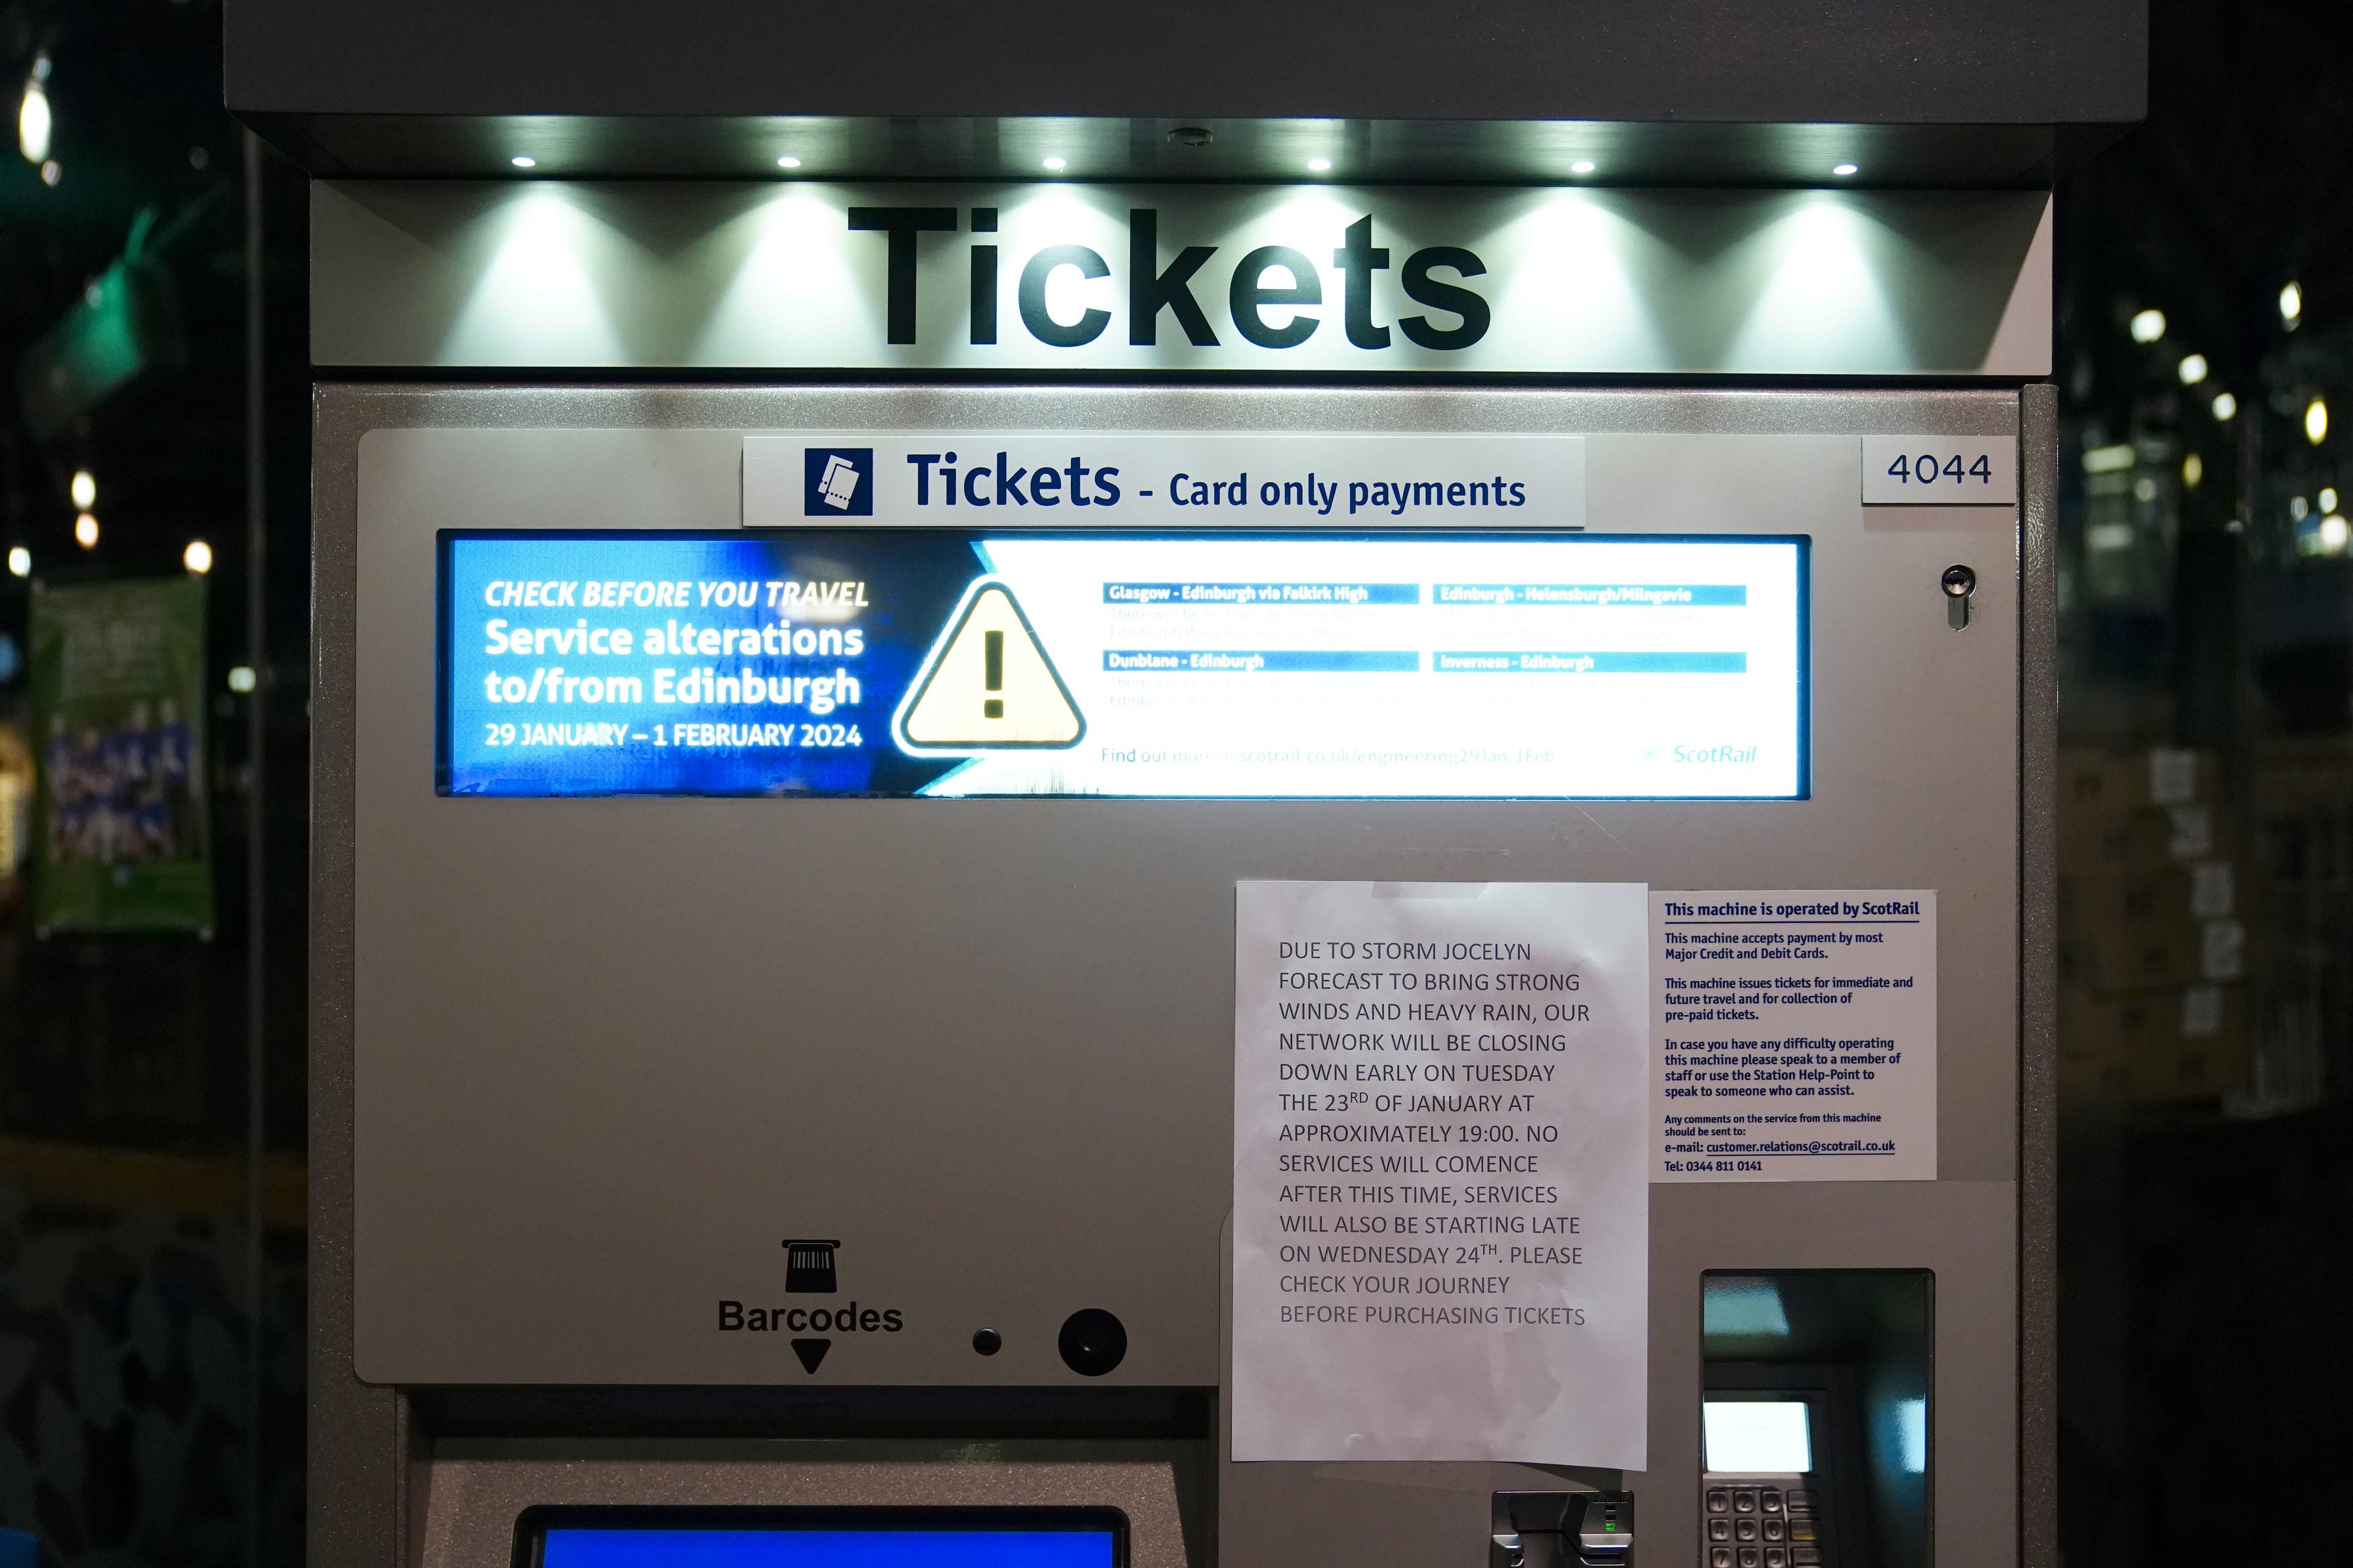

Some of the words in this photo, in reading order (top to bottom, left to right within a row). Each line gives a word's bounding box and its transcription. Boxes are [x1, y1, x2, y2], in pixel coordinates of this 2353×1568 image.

[848, 206, 1490, 350] Tickets
[1888, 454, 1992, 485] 4044
[906, 451, 1121, 507] Tickets
[1170, 472, 1248, 506] Card
[1260, 472, 1338, 515] only
[1349, 476, 1525, 515] payments
[485, 581, 578, 607] CHECK
[582, 581, 692, 607] BEFORE
[699, 581, 758, 607] YOU
[766, 581, 869, 608] TRAVEL
[1109, 585, 1170, 603] Glasgow
[1182, 585, 1256, 603] Edinburgh
[1258, 585, 1281, 600] via
[1283, 586, 1332, 600] Falkirk
[1334, 586, 1368, 603] High
[1441, 587, 1514, 604] Edinburgh
[1525, 587, 1691, 604] Helensburgh/Milngavie
[485, 619, 633, 655] Service
[643, 619, 863, 655] alterations
[1109, 653, 1179, 667] Dunblane
[1190, 653, 1264, 671] Edinburgh
[1441, 655, 1509, 669] Inverness
[1521, 655, 1594, 671] Edinburgh
[484, 667, 642, 703] to/from
[654, 667, 859, 714] Edinburgh
[485, 723, 516, 745] 29
[520, 723, 629, 746] JANUARY
[653, 725, 668, 746] 1
[674, 723, 795, 746] FEBRUARY
[801, 724, 862, 746] 2024
[1101, 747, 1136, 764] Find
[1141, 749, 1167, 764] out
[1674, 745, 1757, 763] ScotRail
[1665, 902, 1694, 916] This
[1698, 902, 1757, 916] machine
[1760, 902, 1773, 915] is
[1776, 901, 1839, 919] operated
[1843, 901, 1860, 919] by
[1862, 901, 1920, 915] ScotRail
[1665, 932, 1688, 944] This
[1691, 932, 1739, 944] machine
[1741, 932, 1785, 946] accepts
[1787, 932, 1837, 946] payment
[1839, 932, 1853, 946] by
[1855, 932, 1884, 943] most
[1279, 942, 1320, 959] DUE
[1326, 942, 1355, 959] TO
[1362, 942, 1436, 960] STORM
[1443, 943, 1530, 960] JOCELYN
[1665, 948, 1698, 962] Major
[1700, 948, 1734, 959] Credit
[1736, 947, 1757, 959] and
[1761, 947, 1792, 959] Debit
[1794, 947, 1829, 959] Cards.
[1280, 972, 1384, 990] FORECAST
[1389, 973, 1417, 990] TO
[1425, 973, 1488, 991] BRING
[1495, 973, 1579, 991] STRONG
[1665, 977, 1687, 989] This
[1689, 977, 1736, 989] machine
[1738, 977, 1772, 989] issues
[1774, 977, 1812, 989] tickets
[1813, 977, 1830, 988] for
[1831, 976, 1890, 988] immediate
[1892, 976, 1913, 988] and
[1665, 993, 1700, 1005] future
[1702, 993, 1737, 1005] travel
[1738, 993, 1759, 1004] and
[1762, 992, 1780, 1004] for
[1781, 992, 1837, 1004] collection
[1840, 992, 1853, 1004] of
[1279, 1003, 1349, 1020] WINDS
[1355, 1003, 1401, 1020] AND
[1408, 1003, 1476, 1021] HEAVY
[1483, 1004, 1537, 1024] RAIN,
[1544, 1004, 1590, 1022] OUR
[1665, 1008, 1714, 1023] pre-paid
[1716, 1008, 1759, 1020] tickets.
[1280, 1033, 1384, 1051] NETWORK
[1390, 1034, 1441, 1051] WILL
[1447, 1034, 1471, 1052] BE
[1478, 1034, 1566, 1052] CLOSING
[1665, 1038, 1677, 1050] In
[1680, 1041, 1705, 1050] case
[1707, 1041, 1728, 1051] you
[1731, 1038, 1758, 1049] have
[1760, 1040, 1782, 1051] any
[1783, 1037, 1837, 1051] difficulty
[1838, 1037, 1895, 1051] operating
[1280, 1063, 1347, 1081] DOWN
[1356, 1064, 1418, 1081] EARLY
[1424, 1065, 1455, 1081] ON
[1462, 1065, 1555, 1082] TUESDAY
[1665, 1085, 1698, 1099] speak
[1700, 1086, 1713, 1097] to
[1715, 1087, 1767, 1097] someone
[1769, 1084, 1793, 1096] who
[1795, 1087, 1815, 1096] can
[1817, 1084, 1855, 1096] assist.
[1278, 1094, 1318, 1111] THE
[1375, 1095, 1402, 1112] OF
[1408, 1095, 1503, 1112] JANUARY
[1508, 1095, 1535, 1112] AT
[1665, 1114, 1683, 1126] Any
[1684, 1114, 1731, 1124] comments
[1747, 1114, 1763, 1123] the
[1764, 1113, 1798, 1123] service
[1799, 1113, 1821, 1123] from
[1823, 1113, 1841, 1122] this
[1843, 1112, 1882, 1122] machine
[1279, 1124, 1451, 1143] APPROXIMATELY
[1459, 1125, 1519, 1143] 19:00.
[1527, 1125, 1558, 1143] NO
[1665, 1126, 1696, 1137] should
[1698, 1126, 1710, 1136] be
[1711, 1127, 1732, 1136] sent
[1732, 1127, 1746, 1136] to:
[1665, 1141, 1704, 1153] e-mail:
[1706, 1139, 1895, 1153] customer.relations@scotrail.co.uk
[1279, 1155, 1373, 1173] SERVICES
[1380, 1155, 1429, 1173] WILL
[1435, 1155, 1538, 1173] COMENCE
[1664, 1161, 1683, 1171] Tel:
[1686, 1161, 1714, 1171] 0344
[1715, 1161, 1734, 1171] 811
[1737, 1161, 1762, 1171] 0141
[1279, 1185, 1343, 1203] AFTER
[1348, 1186, 1394, 1204] THIS
[1400, 1186, 1457, 1207] TIME,
[1464, 1186, 1558, 1204] SERVICES
[1279, 1215, 1328, 1233] WILL
[1334, 1216, 1387, 1233] ALSO
[1394, 1216, 1418, 1234] BE
[1425, 1216, 1524, 1234] STARTING
[1532, 1216, 1580, 1234] LATE
[1280, 1245, 1310, 1262] ON
[1318, 1245, 1449, 1264] WEDNESDAY
[1511, 1246, 1583, 1264] PLEASE
[1280, 1275, 1346, 1292] CHECK
[1352, 1276, 1410, 1294] YOUR
[1415, 1276, 1510, 1294] JOURNEY
[719, 1301, 903, 1332] Barcodes
[1281, 1305, 1358, 1323] BEFORE
[1365, 1306, 1498, 1324] PURCHASING
[1504, 1307, 1585, 1326] TICKETS
